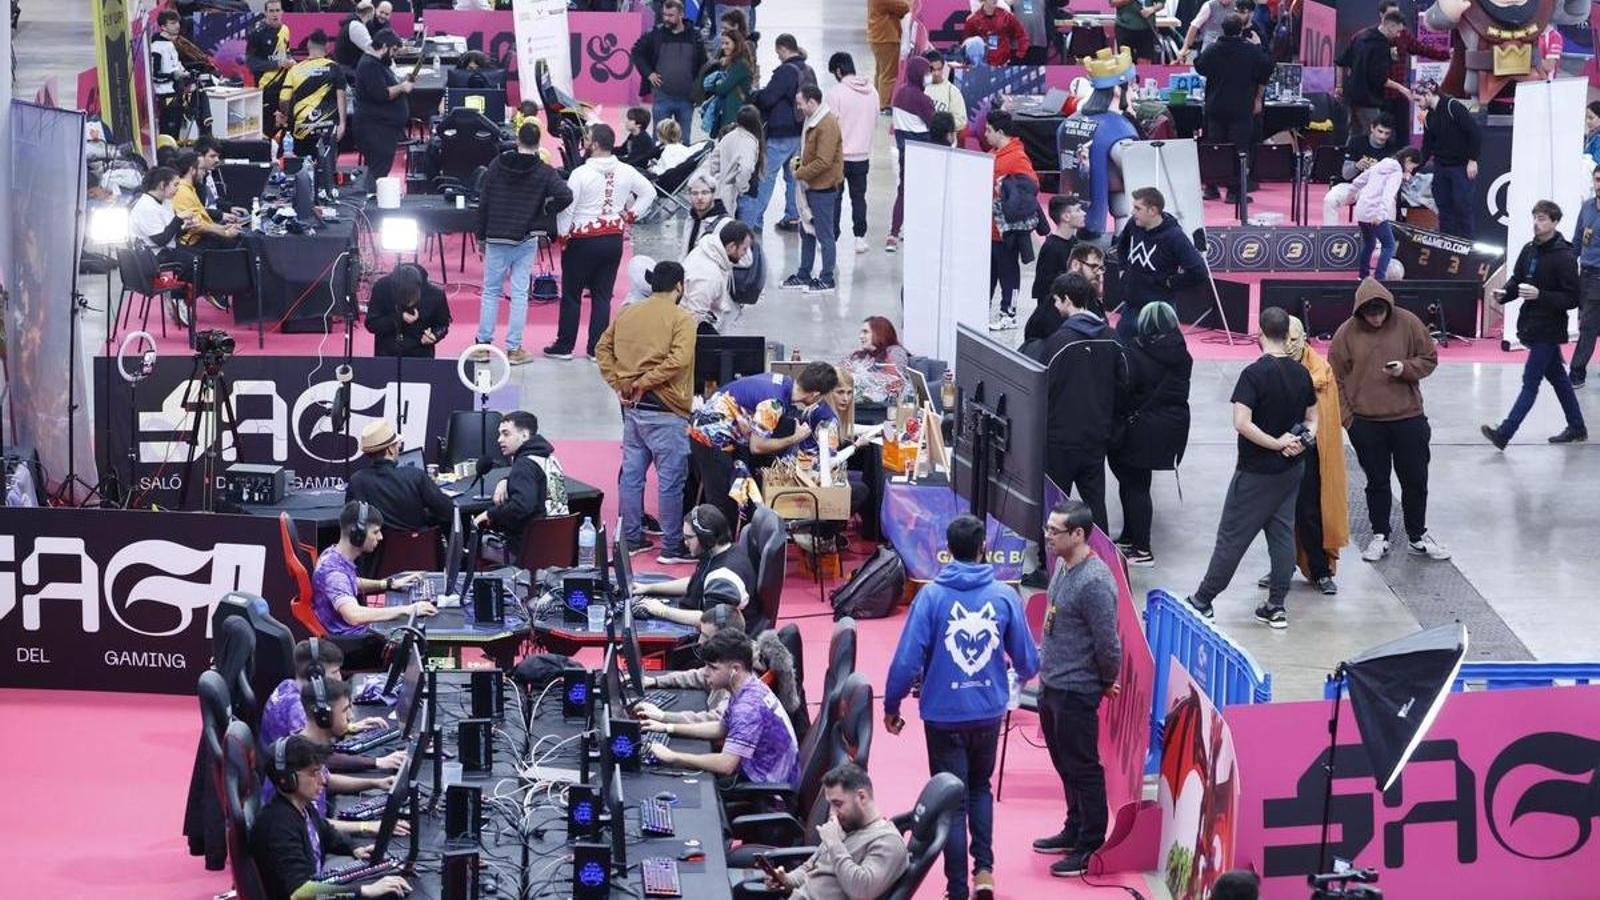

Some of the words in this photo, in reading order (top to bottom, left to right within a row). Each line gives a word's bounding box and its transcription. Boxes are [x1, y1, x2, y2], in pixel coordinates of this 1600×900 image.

[1242, 243, 1259, 258] 2
[1287, 243, 1303, 258] 3
[1331, 243, 1348, 258] 4
[140, 473, 182, 490] SALÓ
[16, 648, 50, 663] DEL
[104, 650, 186, 669] GAMING
